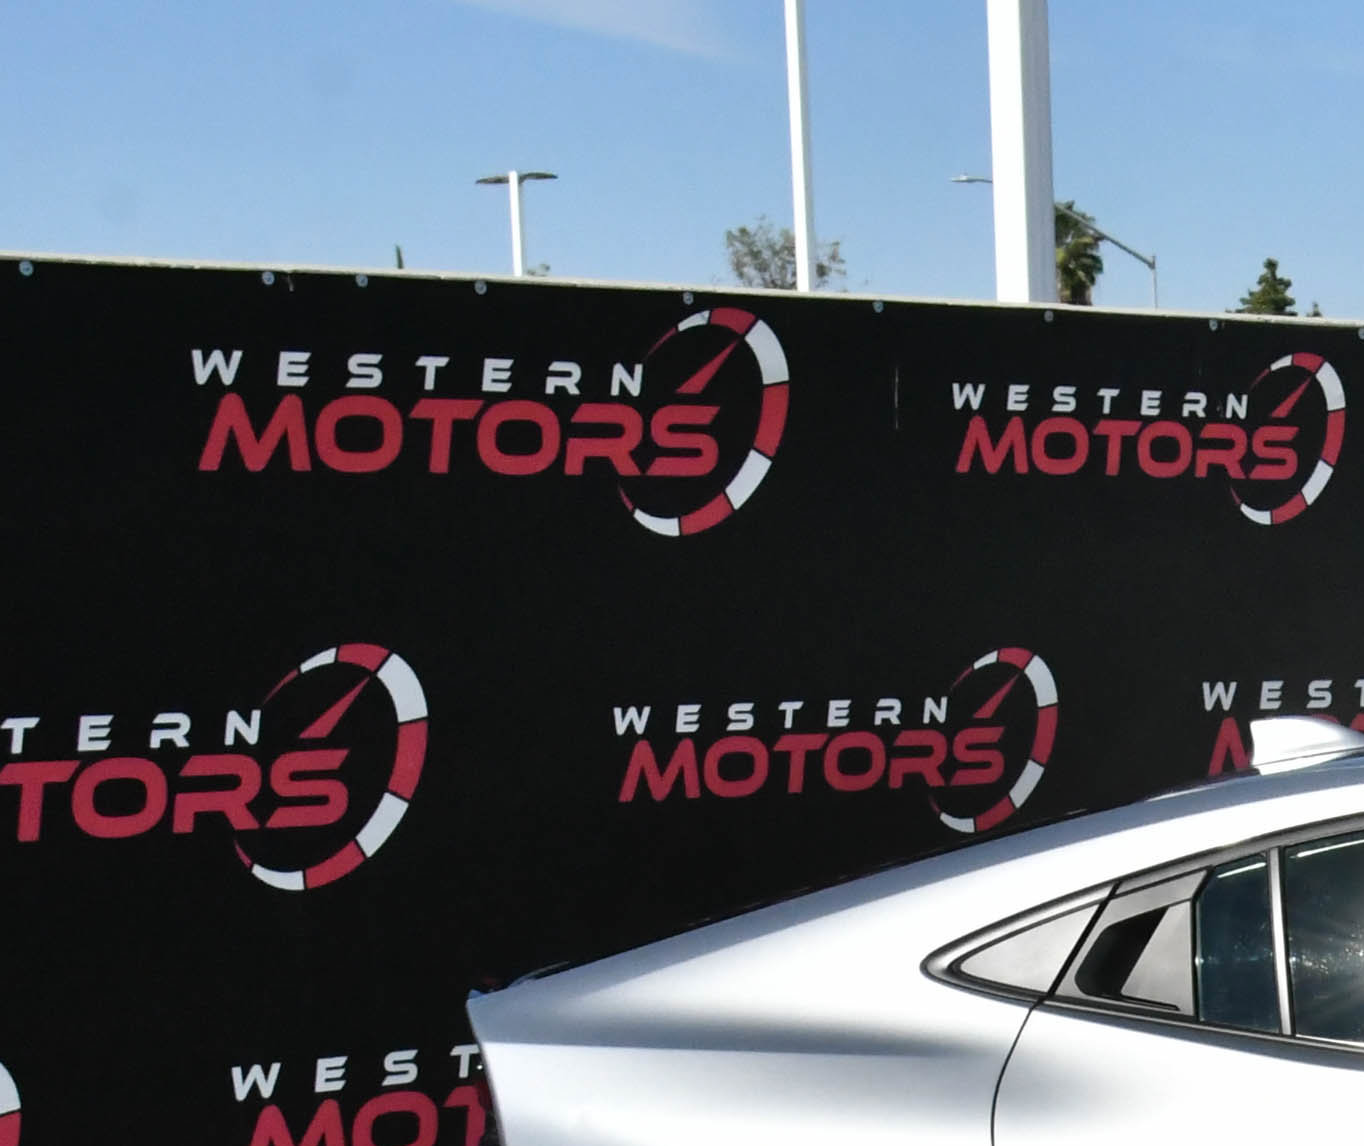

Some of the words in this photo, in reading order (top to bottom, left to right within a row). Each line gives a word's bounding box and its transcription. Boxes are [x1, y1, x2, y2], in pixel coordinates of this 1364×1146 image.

[192, 350, 645, 398] WESTERN
[953, 383, 1249, 420] WESTERN
[199, 393, 721, 478] MOTORS
[956, 415, 1300, 482] MOTORS
[614, 697, 949, 737] WESTERN
[619, 727, 1006, 803] MOTORS
